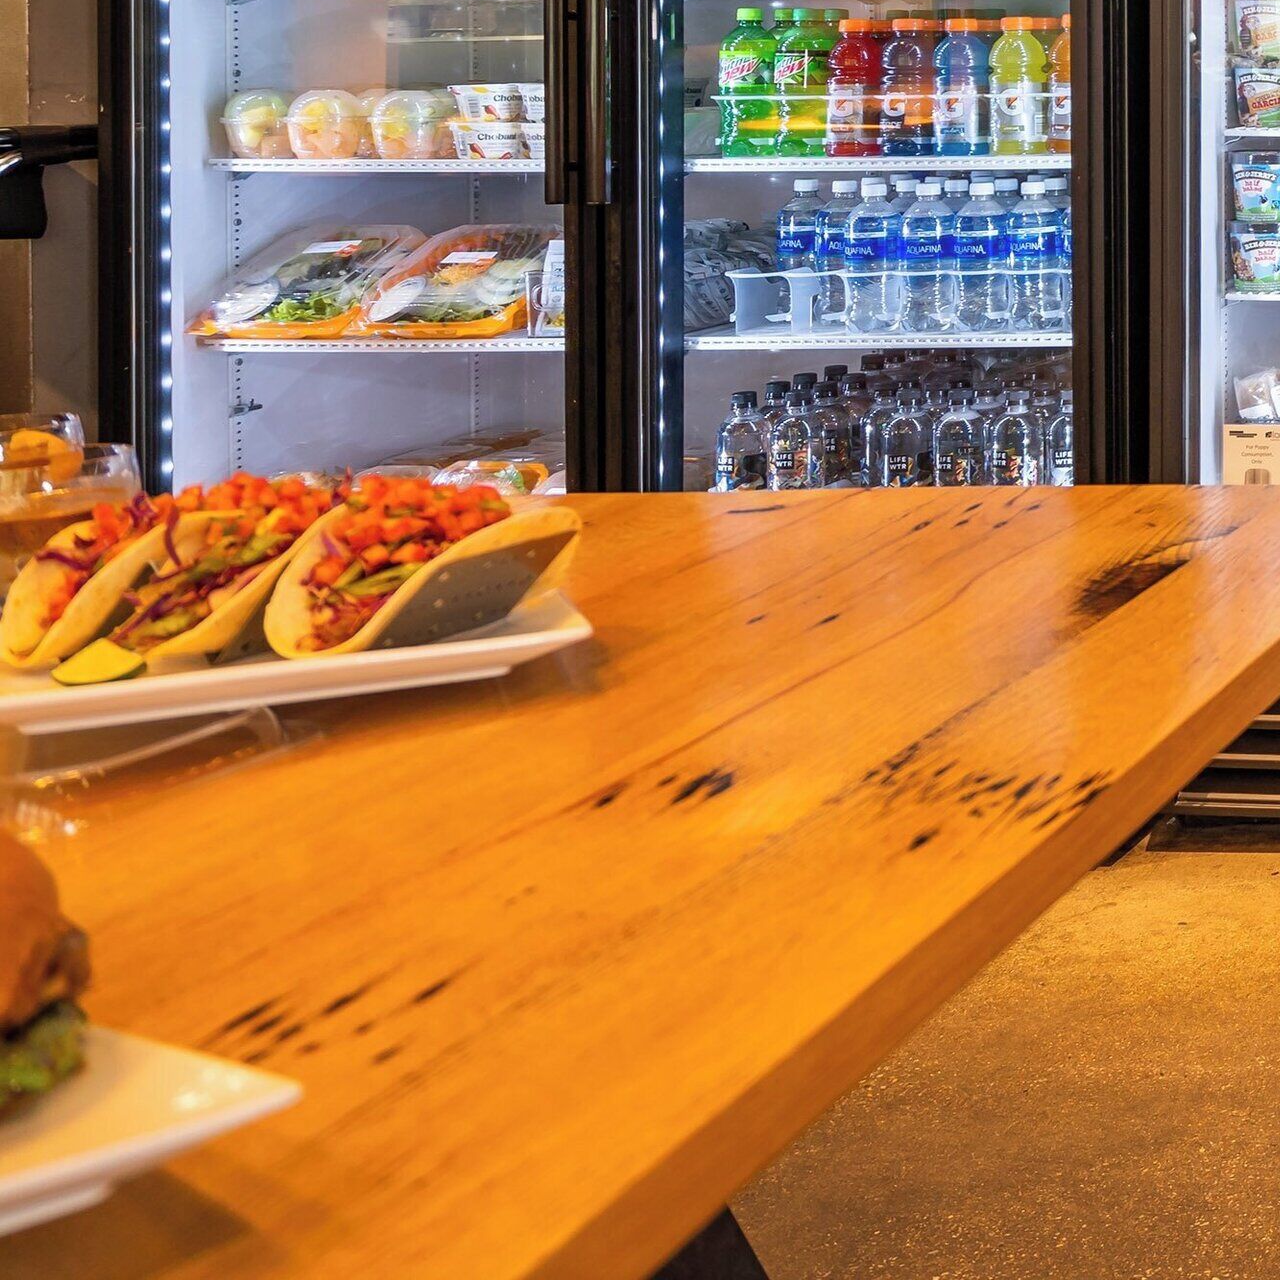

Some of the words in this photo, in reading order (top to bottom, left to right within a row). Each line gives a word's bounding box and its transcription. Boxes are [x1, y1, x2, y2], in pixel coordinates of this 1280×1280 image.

[906, 244, 942, 255] AQUAFINA
[776, 453, 793, 461] LIFE
[889, 456, 907, 464] LIFE
[776, 460, 793, 468] WTR
